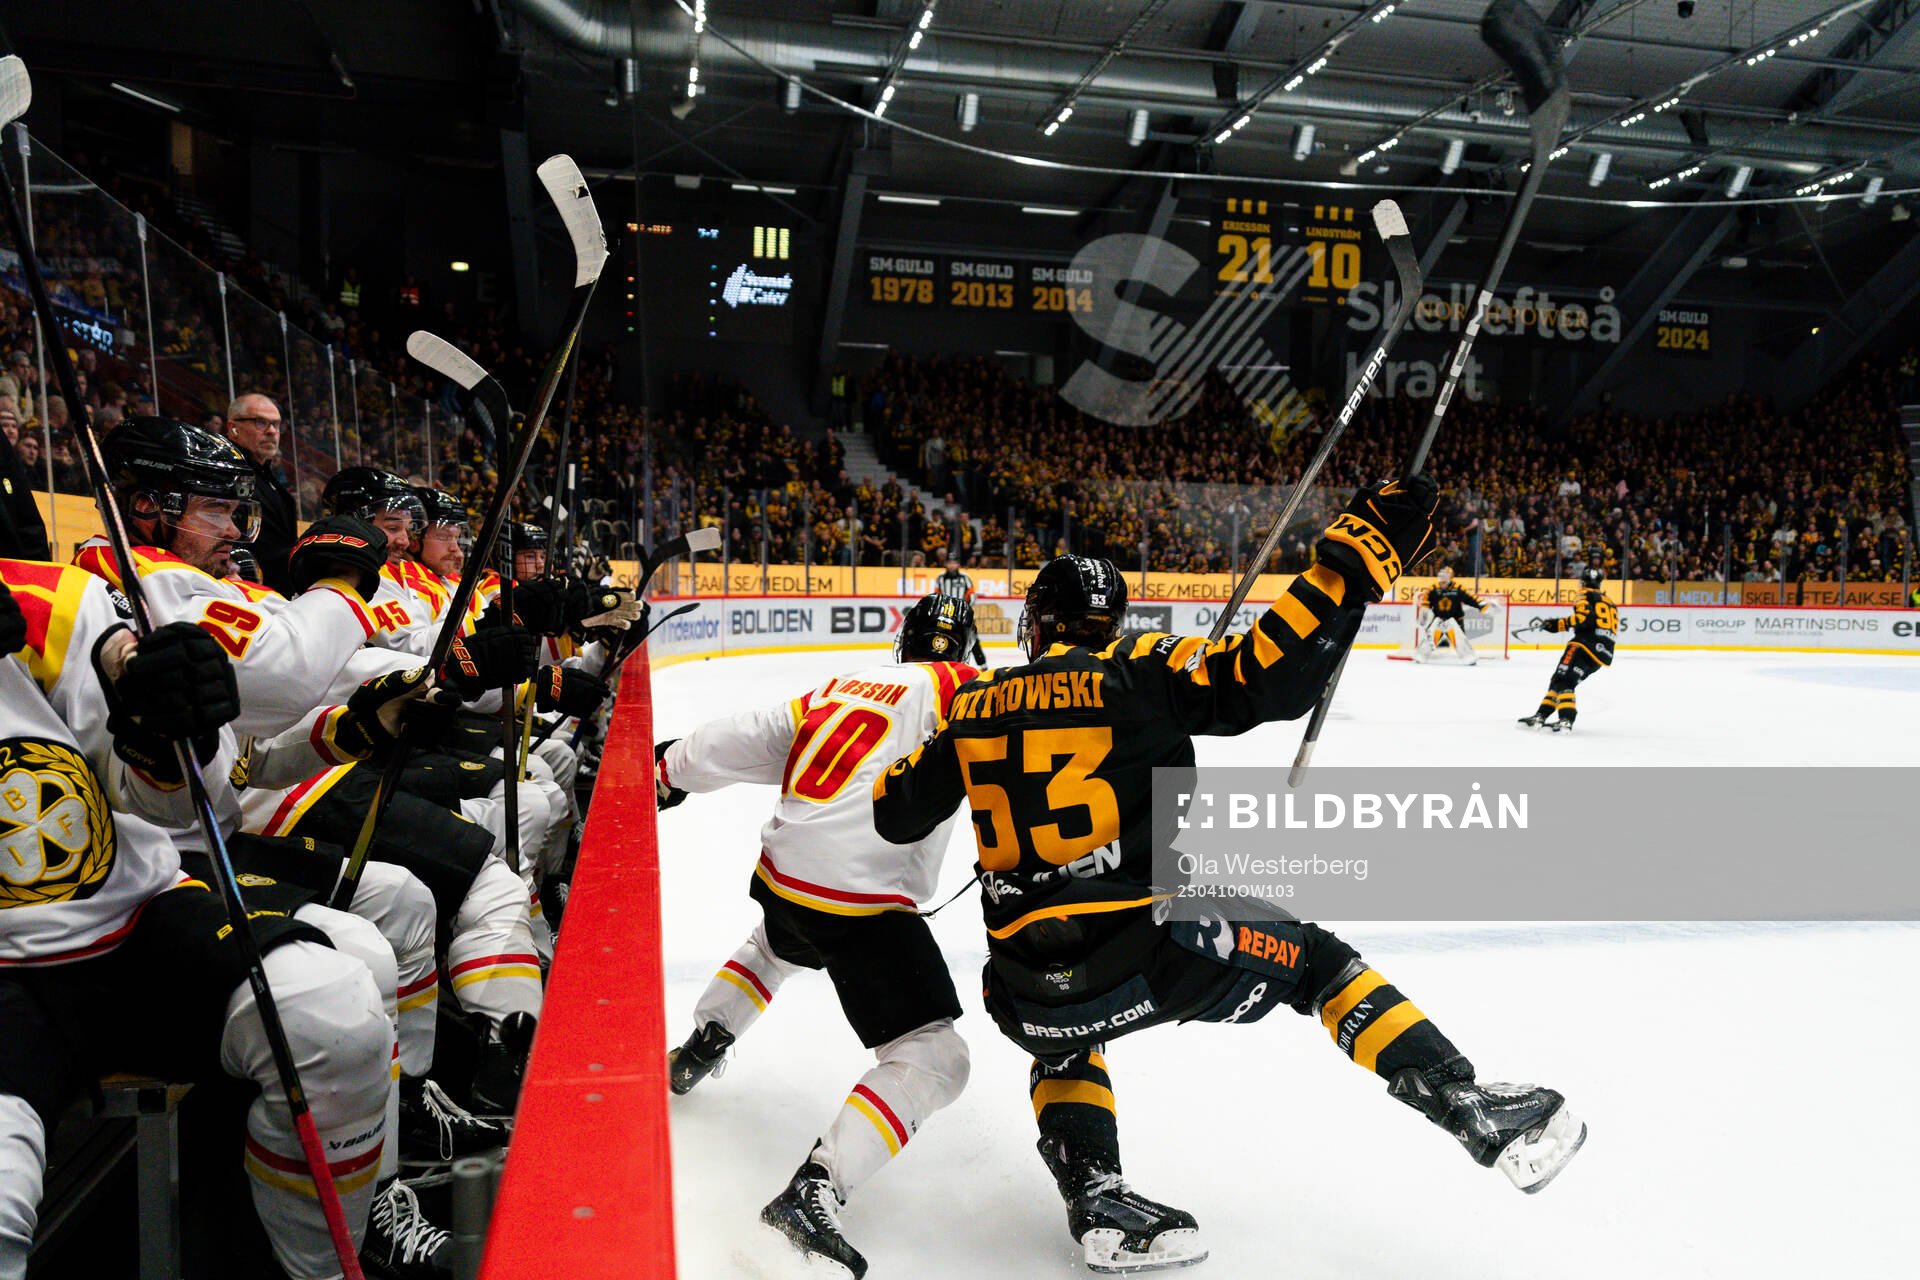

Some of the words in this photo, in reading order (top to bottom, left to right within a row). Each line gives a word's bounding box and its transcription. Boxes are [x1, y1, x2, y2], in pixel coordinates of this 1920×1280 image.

[1222, 220, 1270, 233] ERICSSON
[1218, 234, 1274, 284] 21
[1306, 241, 1361, 289] 10
[870, 276, 934, 304] 1978
[951, 281, 1014, 309] 2013
[1032, 287, 1093, 313] 2014
[1416, 300, 1499, 324] NORH
[1508, 307, 1589, 329] POWER
[1657, 326, 1709, 350] 2024
[1346, 351, 1483, 400] krat
[1091, 593, 1106, 606] 53
[373, 600, 412, 634] 45
[732, 608, 812, 635] BOLIDEN
[1636, 618, 1681, 633] JOB
[1695, 618, 1746, 629] GROUP
[1754, 617, 1879, 632] MARTINSONS
[820, 677, 909, 708] LRSSON
[781, 698, 892, 804] 10
[953, 726, 1121, 872] 53
[1238, 926, 1300, 969] REPAY
[1022, 999, 1155, 1038] BASTU-P.COM
